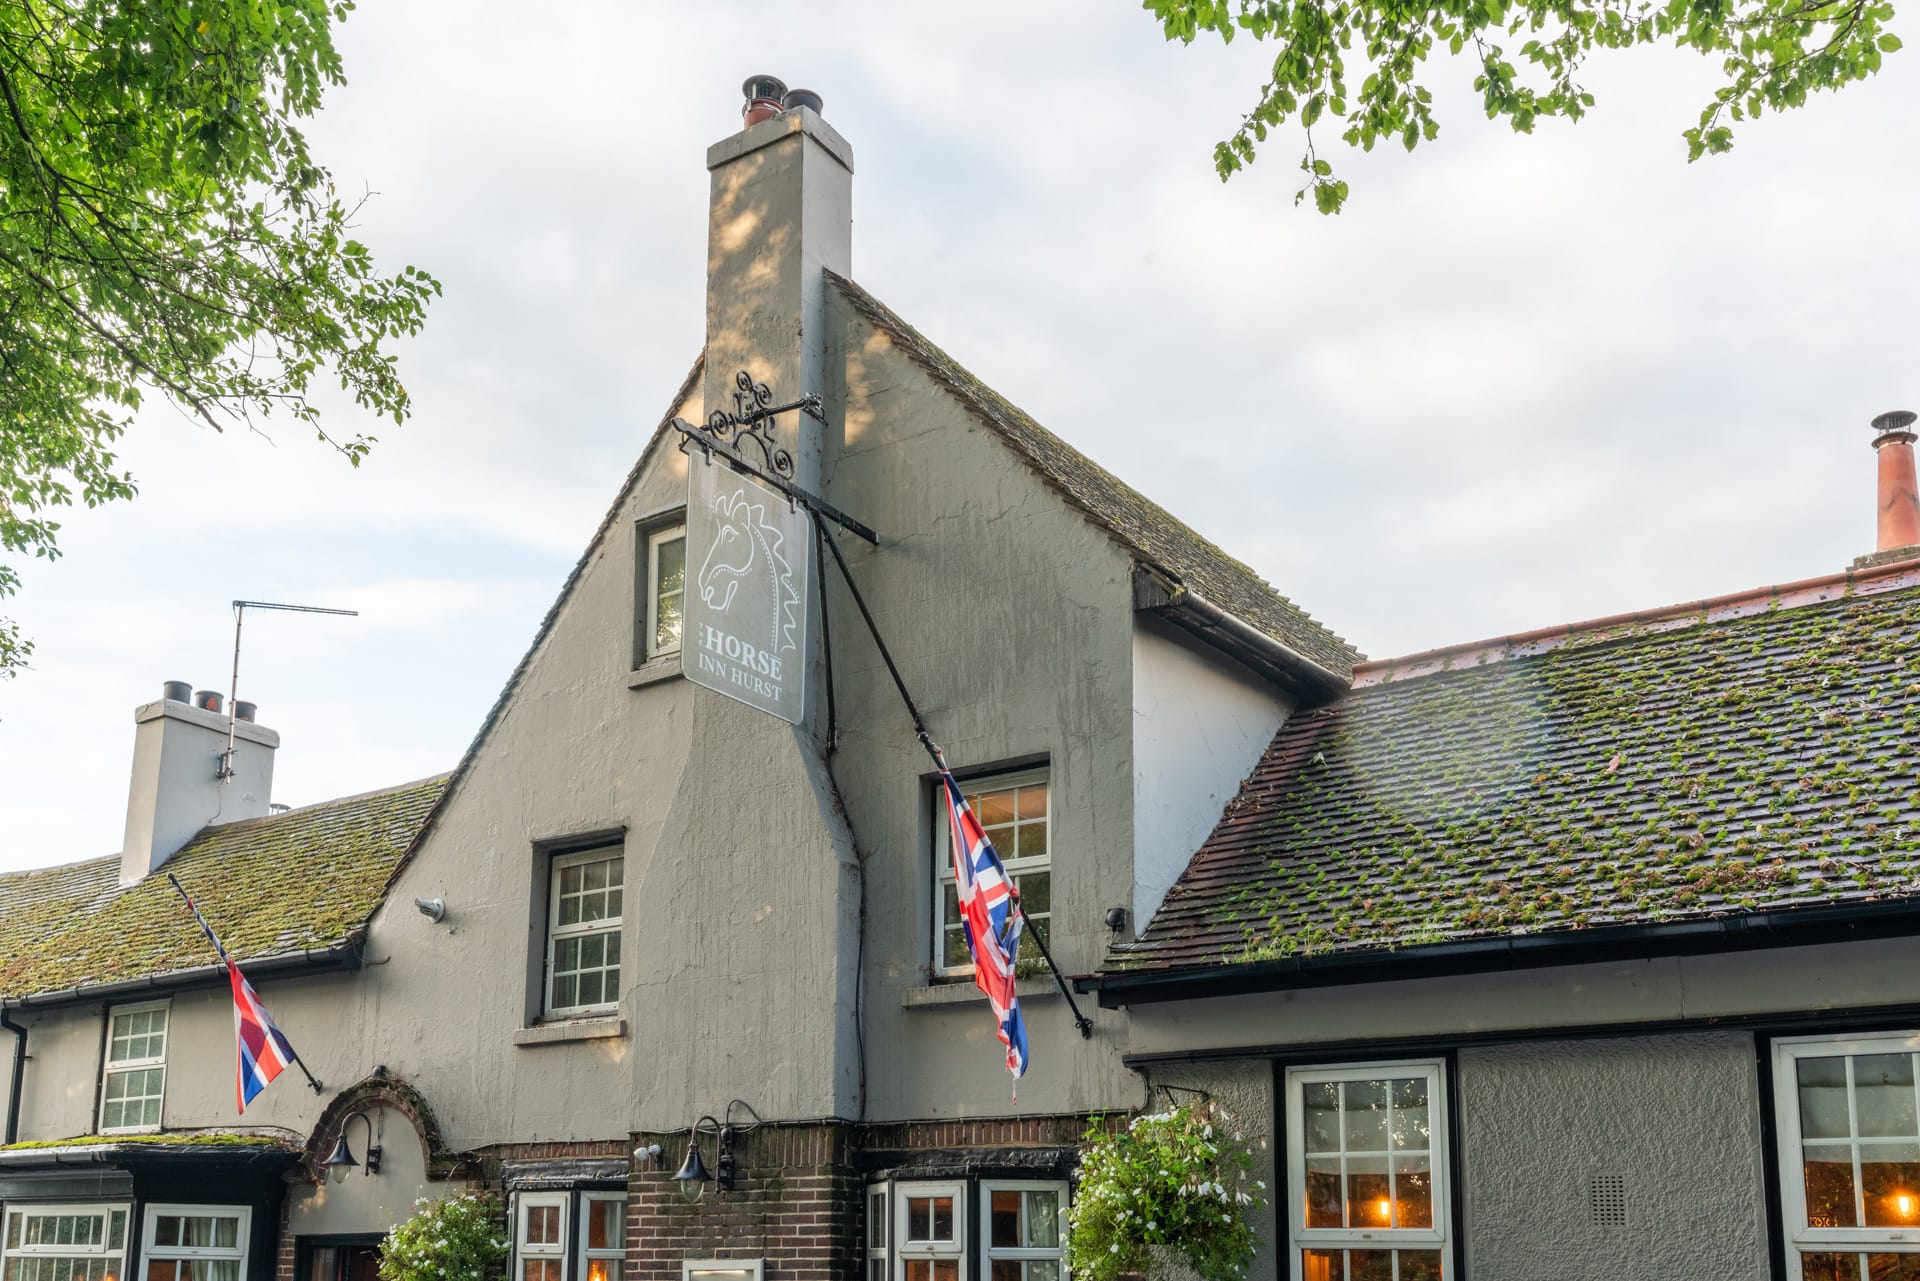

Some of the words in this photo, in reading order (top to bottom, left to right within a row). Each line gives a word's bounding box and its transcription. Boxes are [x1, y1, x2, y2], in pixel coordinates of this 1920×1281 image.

[698, 653, 727, 679] INN
[731, 668, 782, 702] HURST
[704, 625, 782, 681] HORSE
